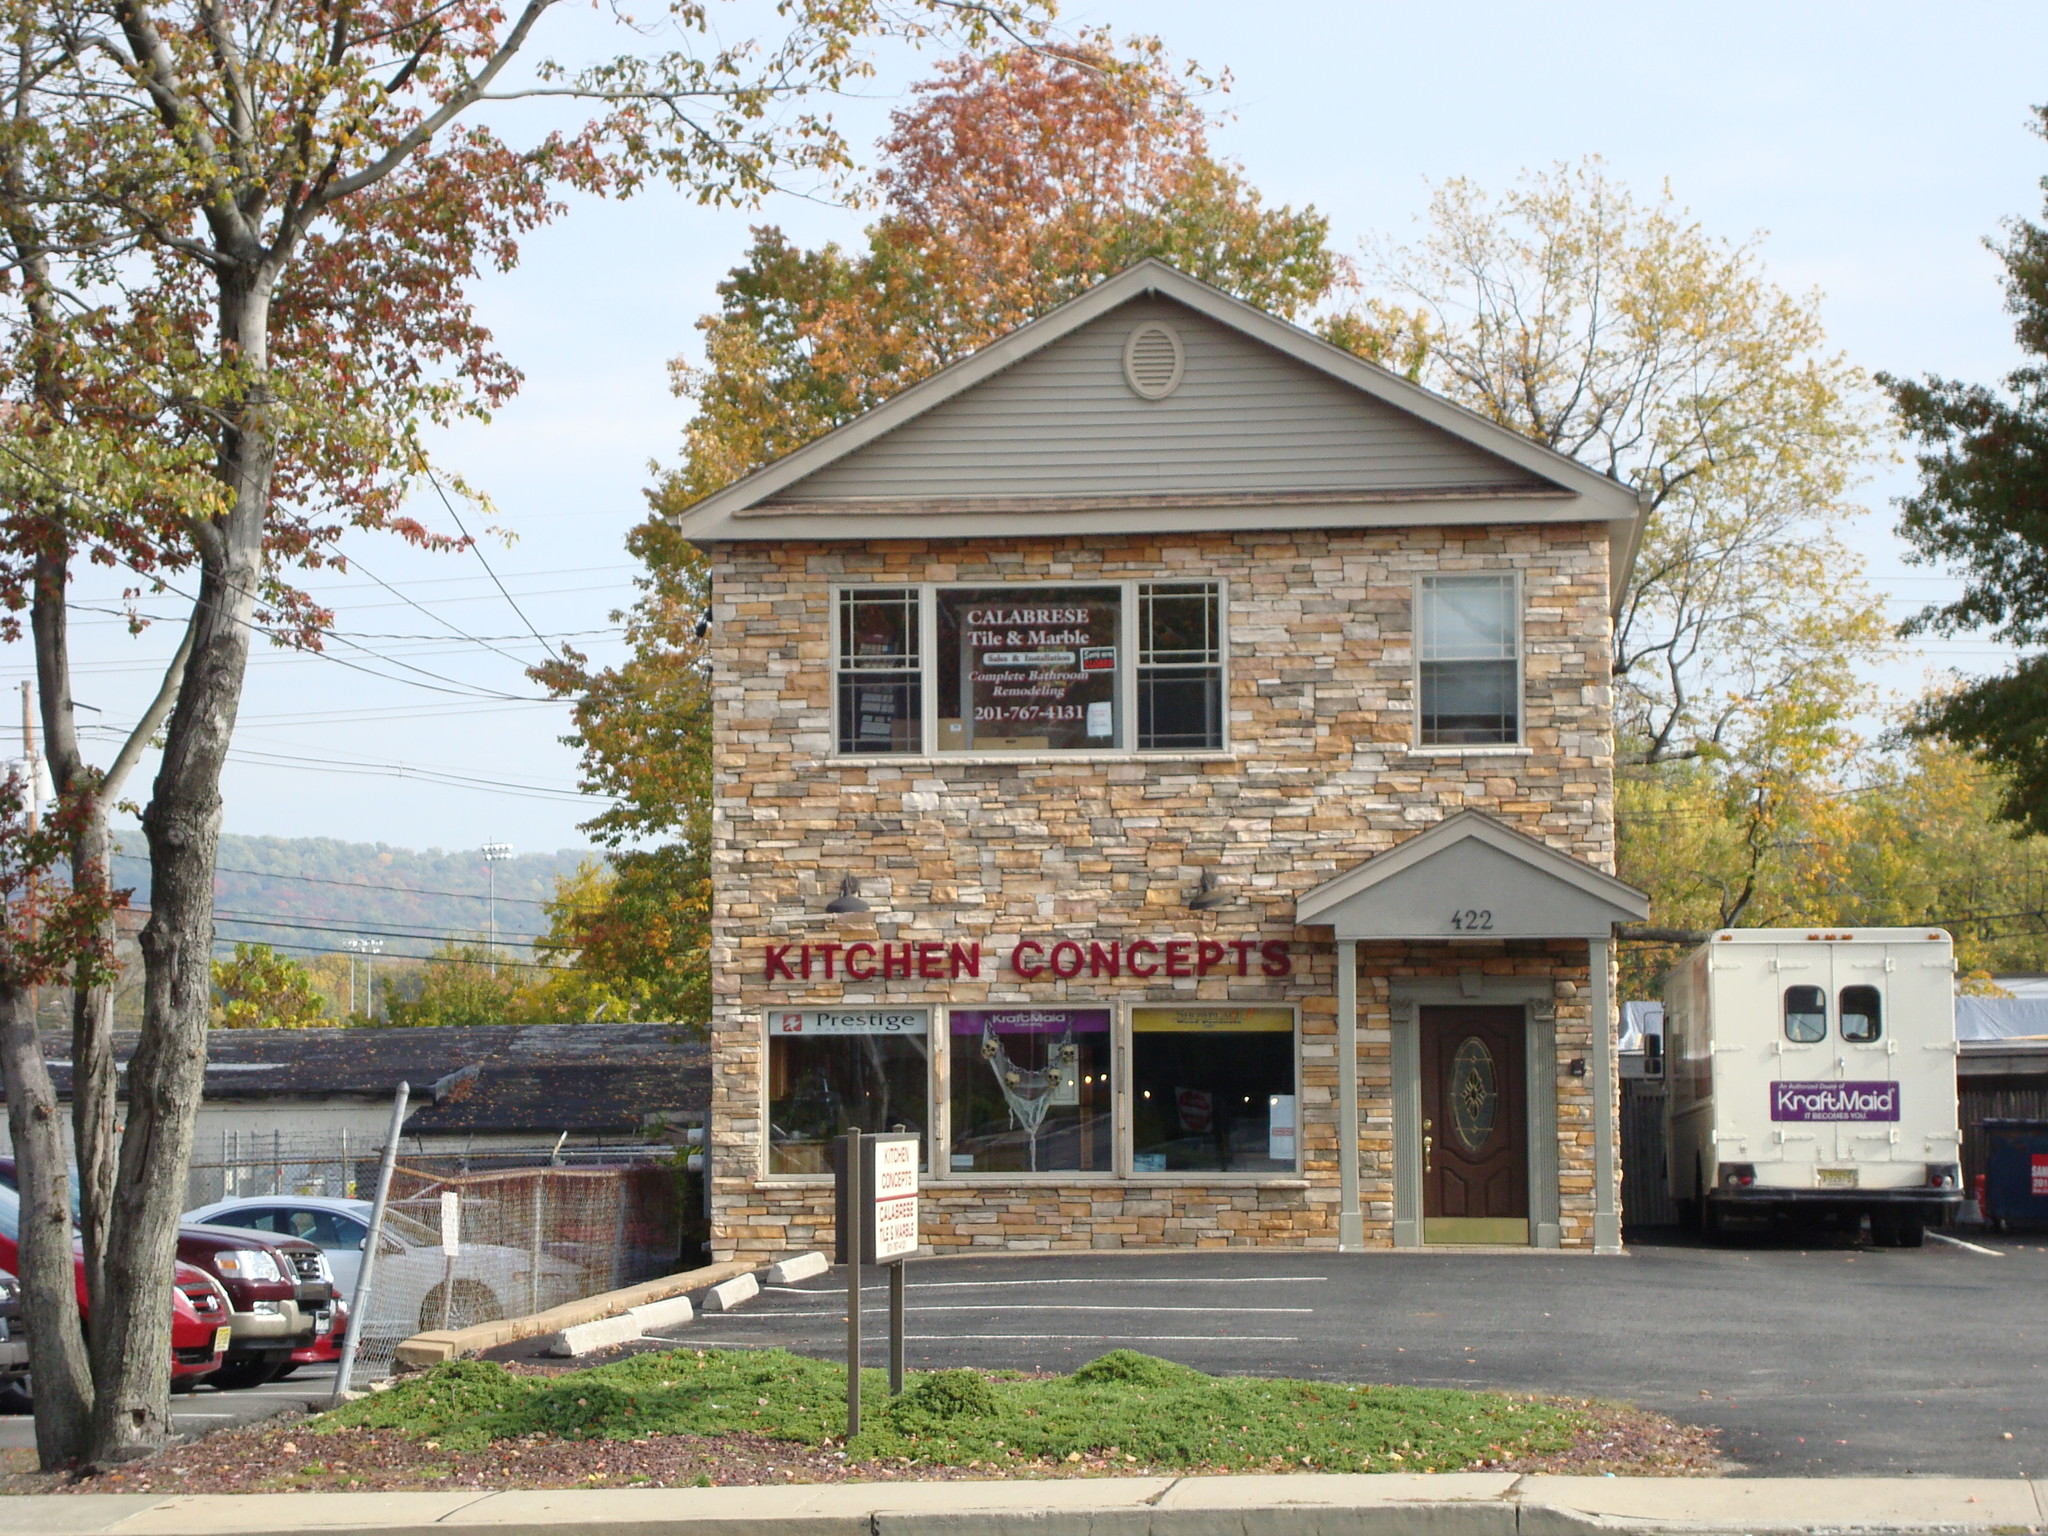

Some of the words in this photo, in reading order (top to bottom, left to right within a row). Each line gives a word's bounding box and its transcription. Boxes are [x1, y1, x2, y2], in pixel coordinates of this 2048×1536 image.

[966, 608, 1090, 625] CALABRESE
[966, 630, 1003, 646] Tile
[1006, 630, 1023, 646] &
[1027, 629, 1090, 645] Marble
[987, 654, 1008, 662] Sales
[1011, 654, 1020, 662] &
[1024, 654, 1071, 662] Installation
[968, 670, 1026, 684] Complete
[1028, 669, 1089, 681] Bathroom
[992, 685, 1066, 698] Remodeling
[974, 704, 1084, 721] 201-767-4131
[1451, 909, 1494, 930] 422
[765, 942, 980, 980] KITCHEN
[1011, 939, 1292, 979] CONCEPTS
[816, 1012, 915, 1031] Prestige
[992, 1012, 1066, 1024] KraftMaid
[1777, 1089, 1893, 1111] KraftMaid
[1804, 1112, 1811, 1120] IT
[1812, 1112, 1850, 1120] BECOMES
[884, 1145, 910, 1164] KITCHEN
[881, 1170, 912, 1189] CONCEPTS
[879, 1201, 914, 1223] CALABRESE
[879, 1225, 889, 1242] TILE
[894, 1221, 914, 1240] MARBLE
